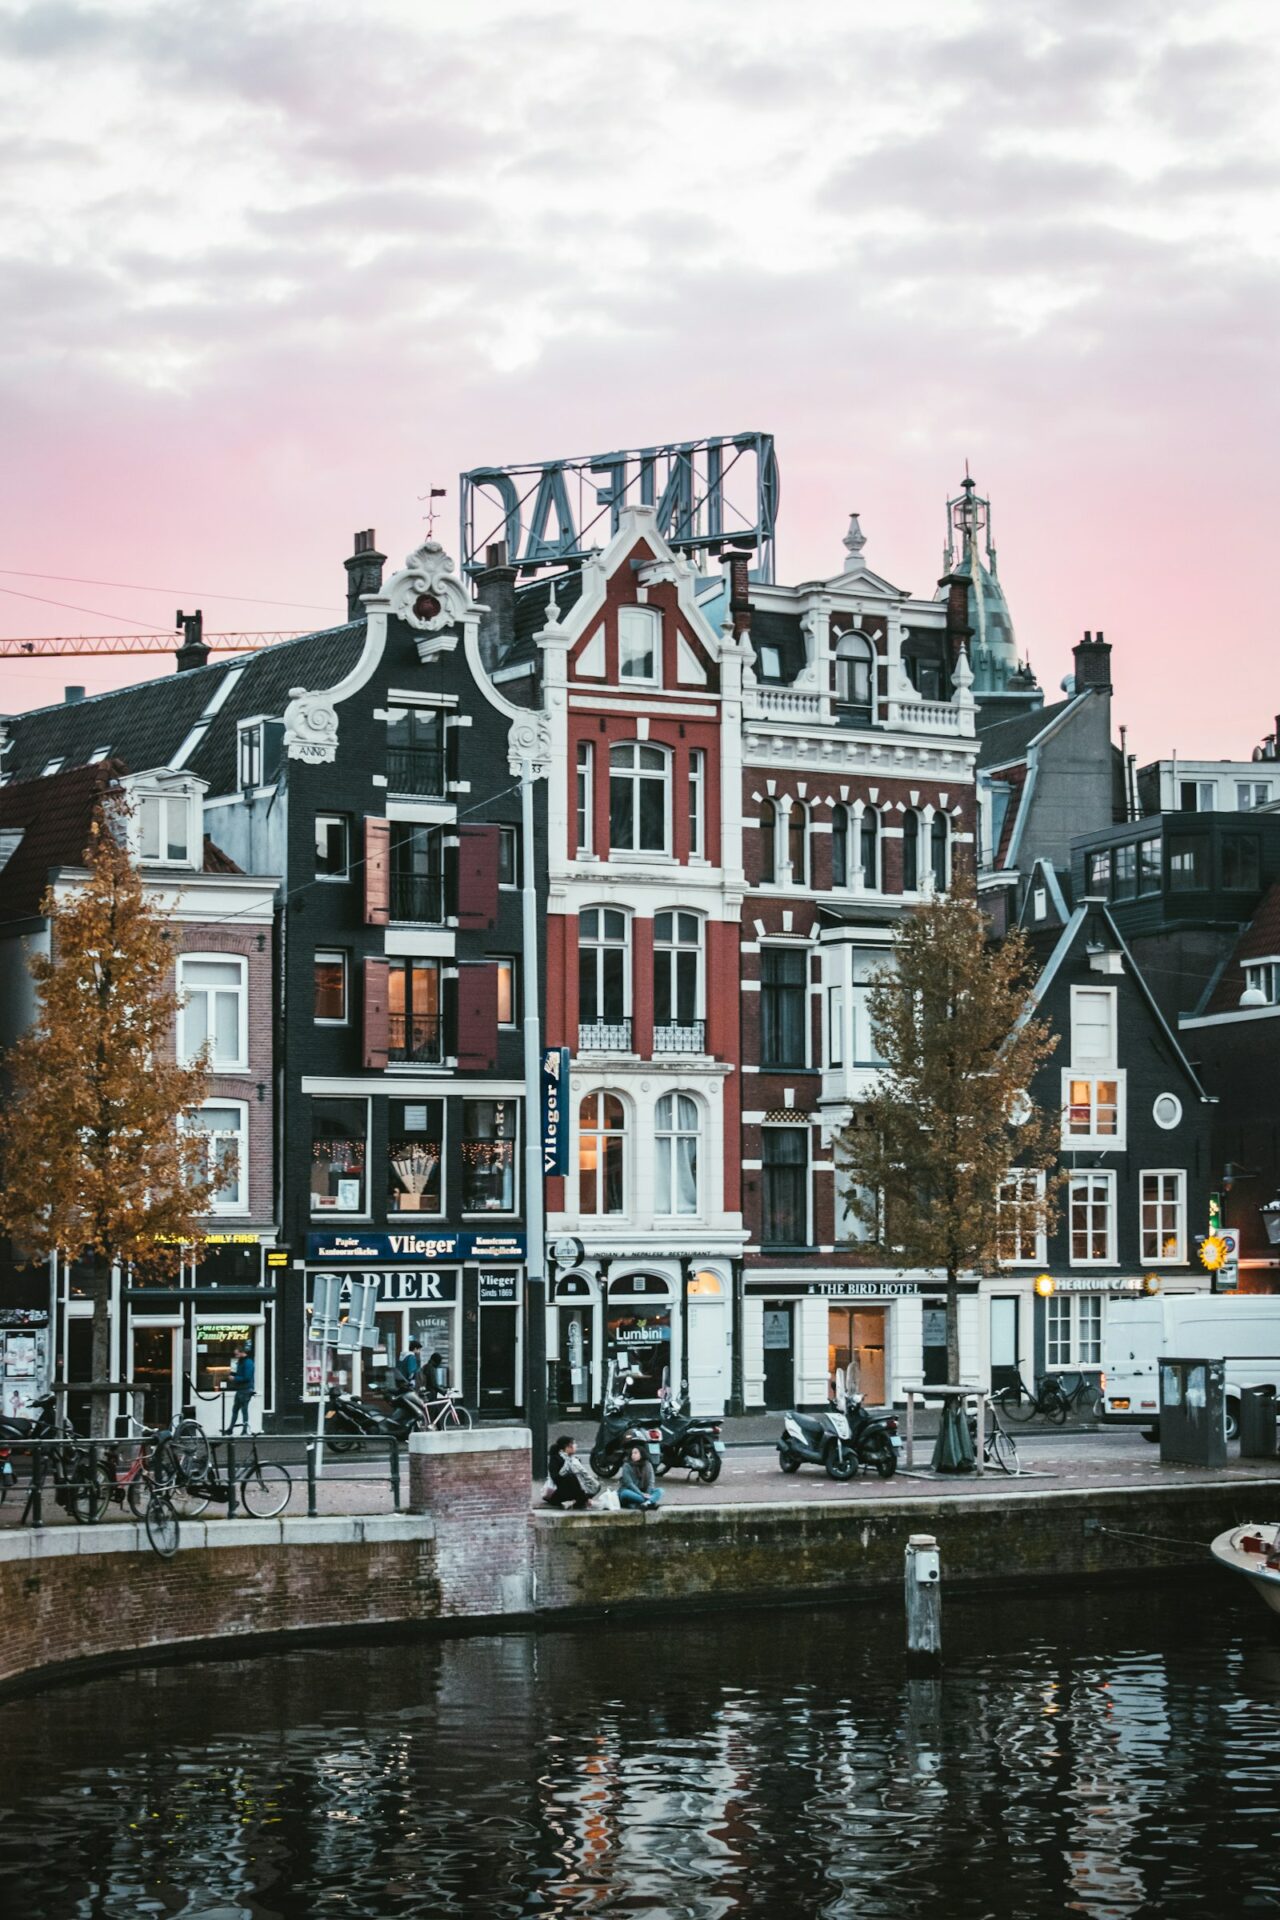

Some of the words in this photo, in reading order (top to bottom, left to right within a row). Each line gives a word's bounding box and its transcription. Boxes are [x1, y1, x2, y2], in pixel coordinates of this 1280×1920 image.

[299, 746, 326, 757] ANNO
[545, 1084, 560, 1173] Vlieger
[203, 1234, 231, 1244] AMILY
[233, 1234, 260, 1244] FIRST
[335, 1237, 359, 1248] Papier
[388, 1235, 457, 1258] Vlieger
[328, 1272, 443, 1300] APIER
[479, 1274, 515, 1287] Vlieger
[818, 1283, 845, 1294] THE
[848, 1283, 876, 1294] BIRD
[880, 1283, 921, 1294] HOTEL
[415, 1318, 447, 1328] VLIEGER
[197, 1331, 226, 1342] Family
[227, 1331, 249, 1340] First
[616, 1326, 662, 1340] Lumbini
